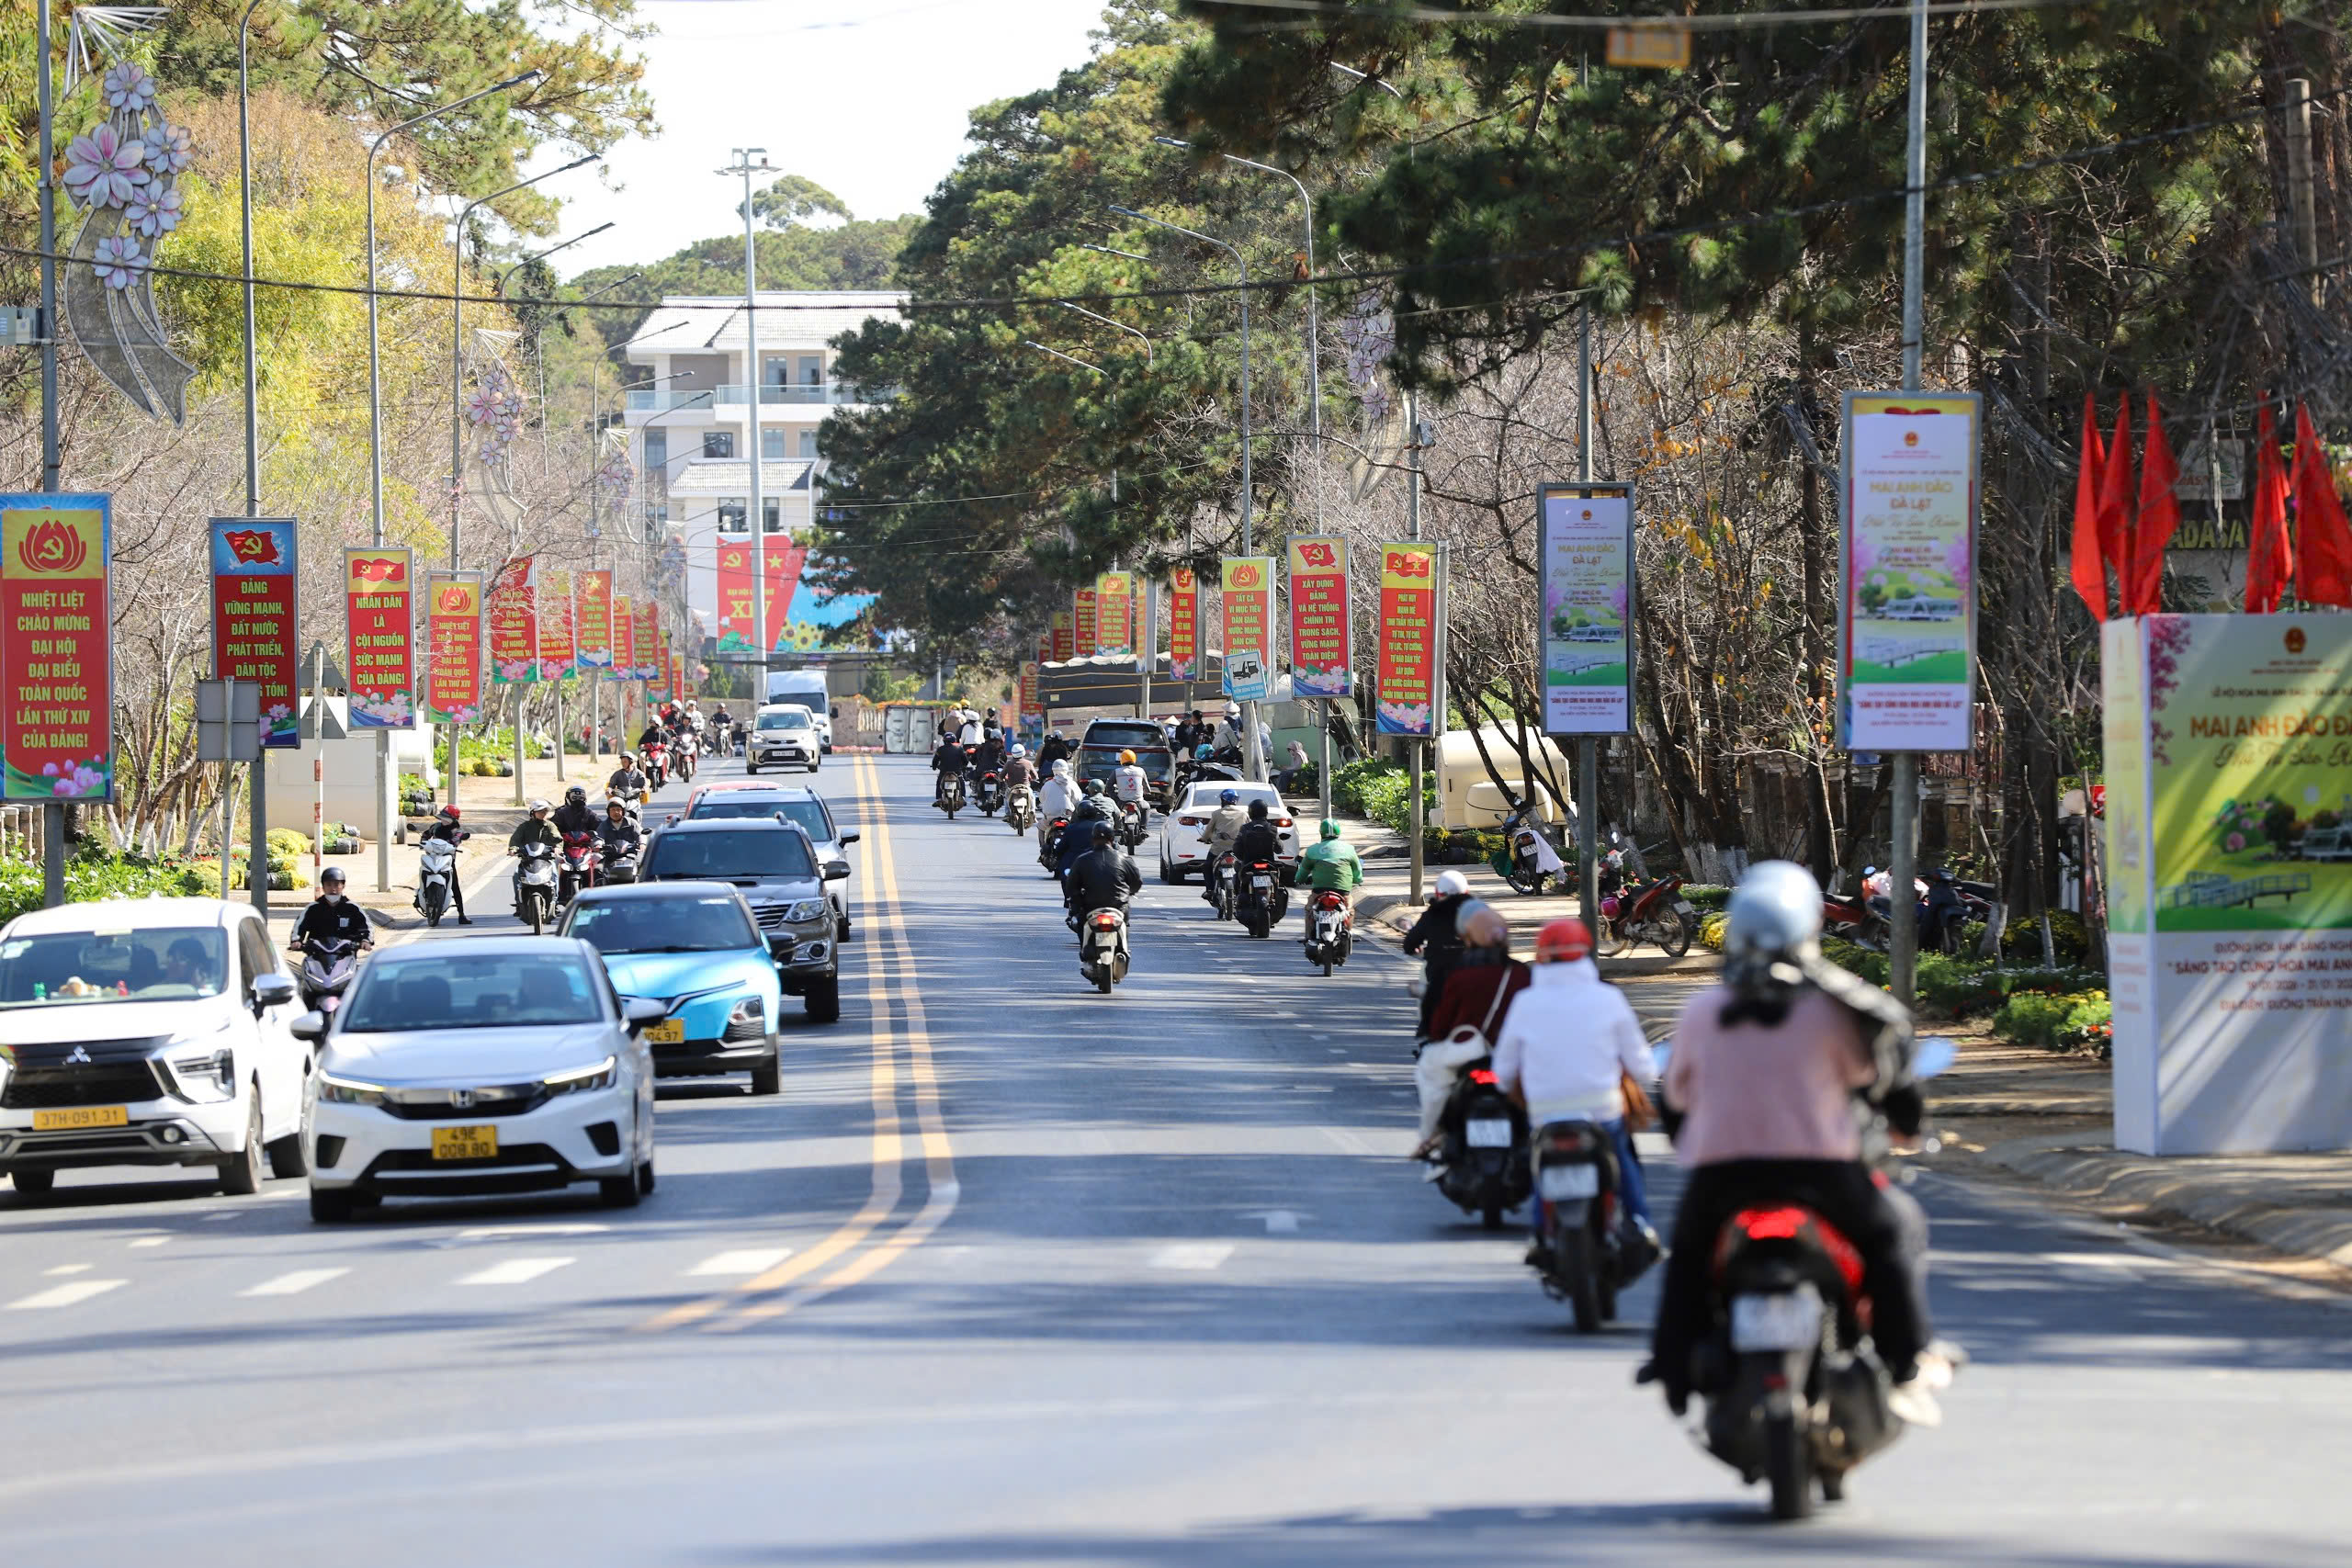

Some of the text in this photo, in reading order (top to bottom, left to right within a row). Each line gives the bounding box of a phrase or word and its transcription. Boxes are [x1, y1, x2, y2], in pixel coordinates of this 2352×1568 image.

[1890, 495, 1932, 513] ĐÀ LẠT
[1573, 553, 1602, 566] ĐÀ LẠT
[241, 578, 267, 593] ĐẢNG
[1302, 579, 1334, 589] XÂY DỰNG
[22, 590, 85, 610] NHIỆT LIỆT
[356, 594, 402, 608] NHÂN DÂN
[1309, 590, 1328, 600] ĐẢNG
[224, 600, 285, 616] VỮNG MẠNH,
[1298, 601, 1340, 614] VÀ HỆ THỐNG
[17, 614, 90, 631] CHÀO MỪNG
[232, 618, 278, 635] ĐẤT NƯỚC
[374, 614, 385, 627] LÀ
[1304, 615, 1335, 625] CHÍNH TRỊ
[356, 631, 404, 649] CỘI NGUỒN
[1298, 627, 1340, 637] TRONG SẠCH,
[31, 637, 76, 657] ĐẠI HỘI
[227, 639, 285, 657] PHÁT TRIỂN,
[1300, 639, 1339, 649] VỮNG MẠNH
[356, 652, 402, 668] SỨC MẠNH
[1302, 650, 1338, 661] TOÀN DIỆN!
[28, 658, 80, 681] ĐẠI BIỂU
[236, 662, 277, 679] DÂN TỘC
[356, 670, 404, 684] CỦA ĐẢNG!
[18, 682, 87, 703] TOÀN QUỐC
[266, 681, 287, 696] TỒN!
[17, 705, 90, 724] LẦN THỨ XIV
[2190, 707, 2352, 738] MAI ANH ĐÀO Đ
[22, 728, 88, 748] CỦA ĐẢNG!
